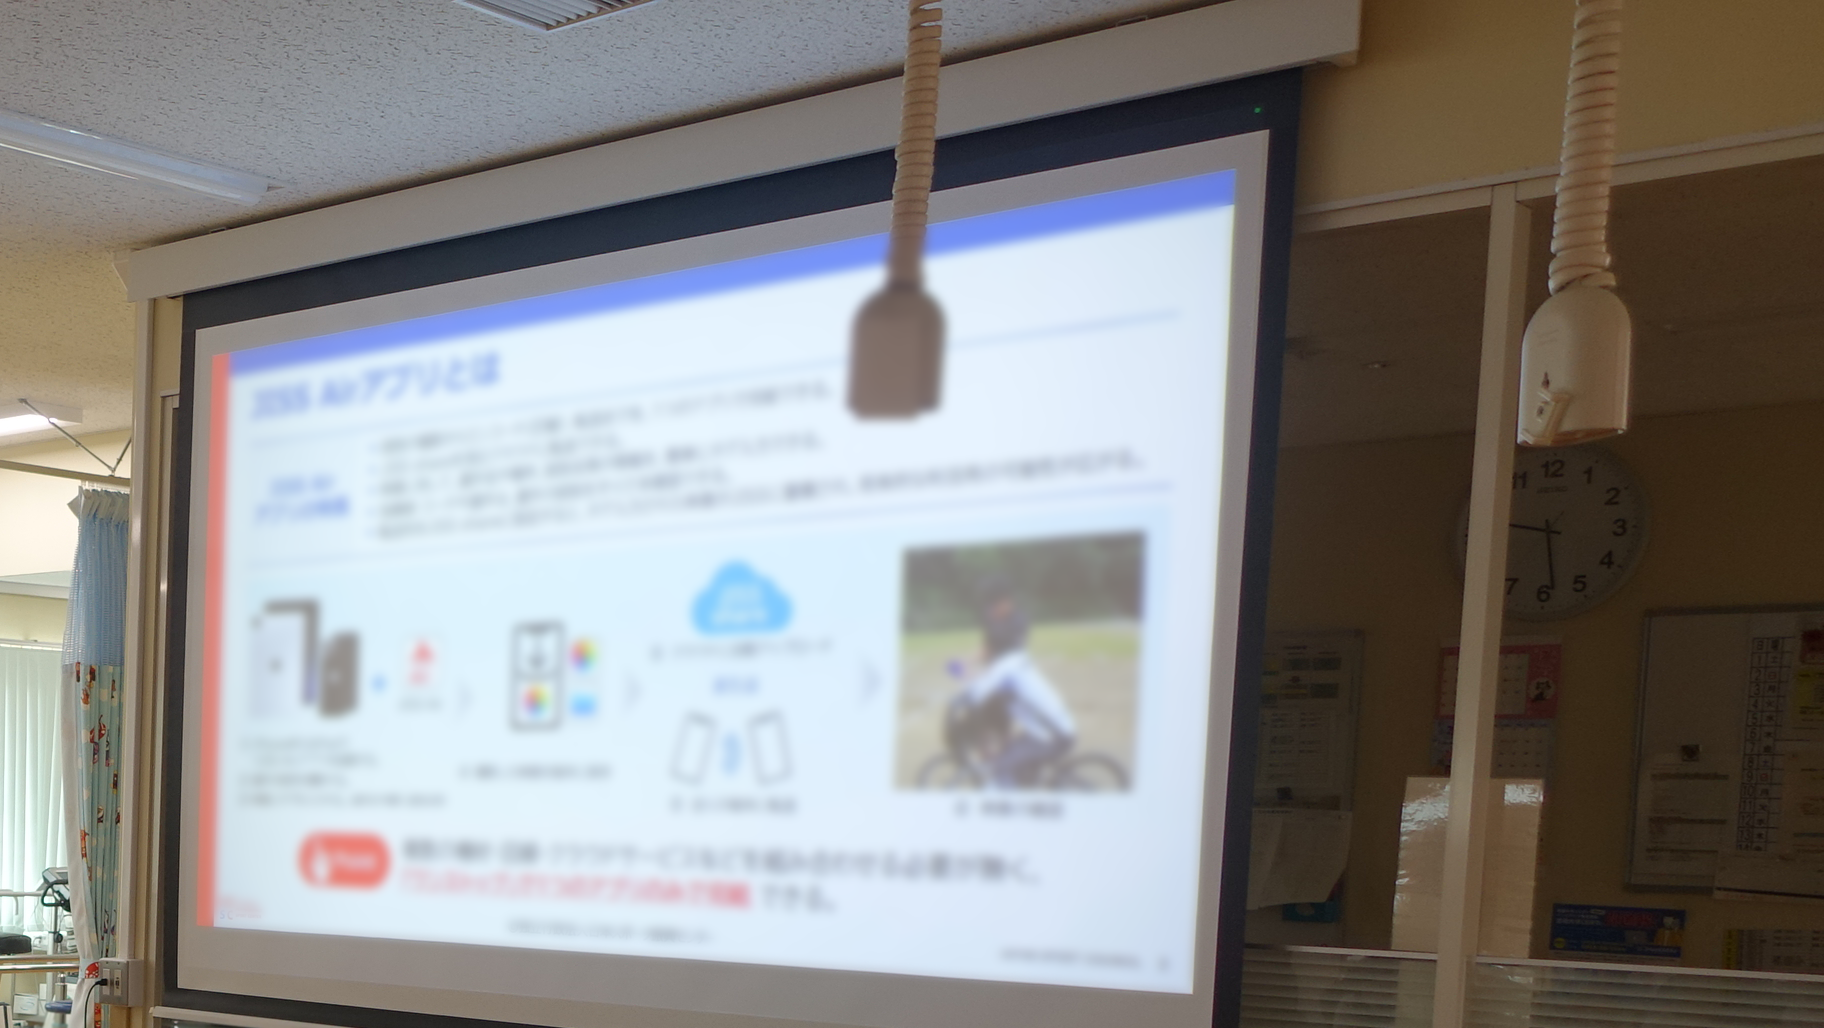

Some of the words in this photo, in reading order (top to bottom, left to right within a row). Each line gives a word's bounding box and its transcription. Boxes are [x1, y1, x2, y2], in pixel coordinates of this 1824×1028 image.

[1541, 459, 1565, 478] 12
[1583, 467, 1593, 484] 1
[1604, 487, 1621, 505] 2
[1612, 519, 1627, 536] 3
[1599, 551, 1613, 569] 4
[1505, 578, 1519, 595] 7
[1573, 575, 1587, 592] 5
[1536, 585, 1550, 602] 6
[1755, 669, 1761, 681] 2
[1754, 684, 1760, 695] 3
[1753, 699, 1758, 709] 4
[1752, 713, 1758, 725] 5
[1750, 728, 1756, 739] 6
[1748, 742, 1755, 752] 7
[1748, 757, 1753, 767] 8
[1747, 771, 1753, 782] 9
[1744, 786, 1753, 796] 10
[1741, 815, 1751, 826] 12
